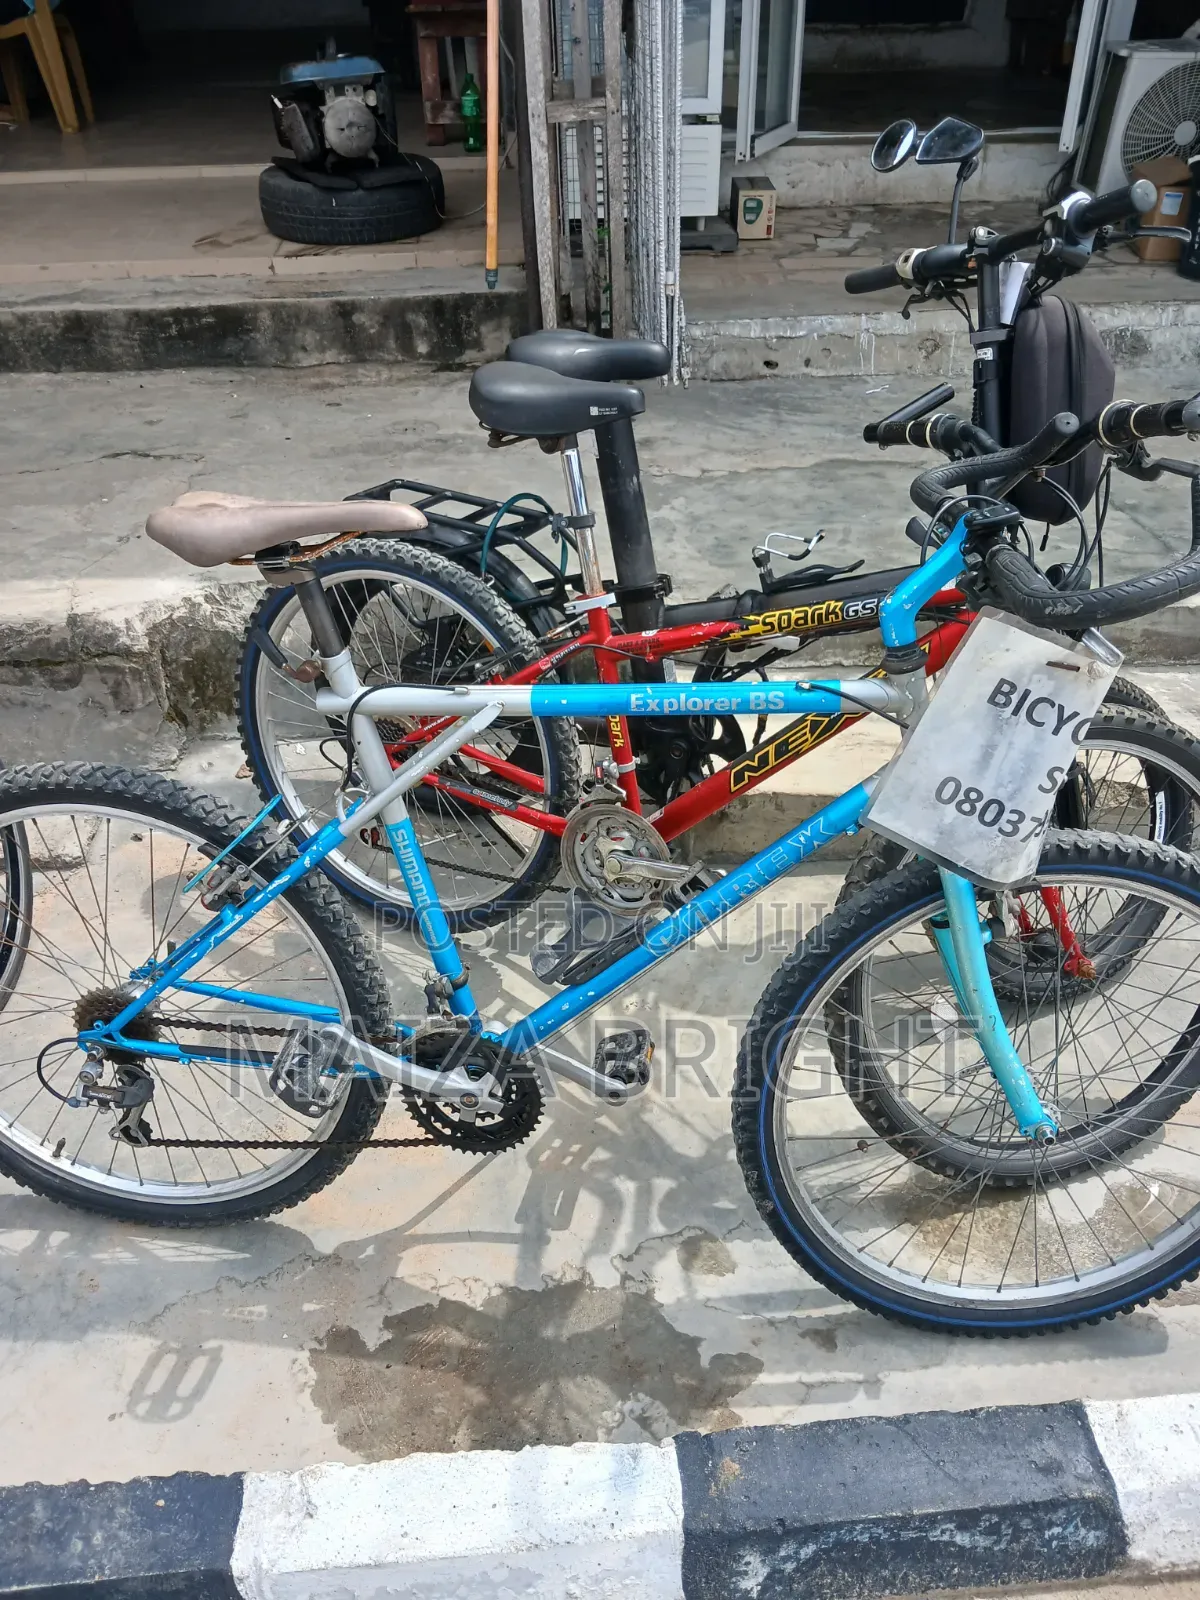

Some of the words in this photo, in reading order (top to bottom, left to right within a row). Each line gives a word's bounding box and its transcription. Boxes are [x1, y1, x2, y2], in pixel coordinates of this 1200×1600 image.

[759, 600, 844, 635] spark
[630, 692, 742, 715] Explorer
[749, 690, 786, 711] BS
[392, 828, 431, 908] SHIMANO
